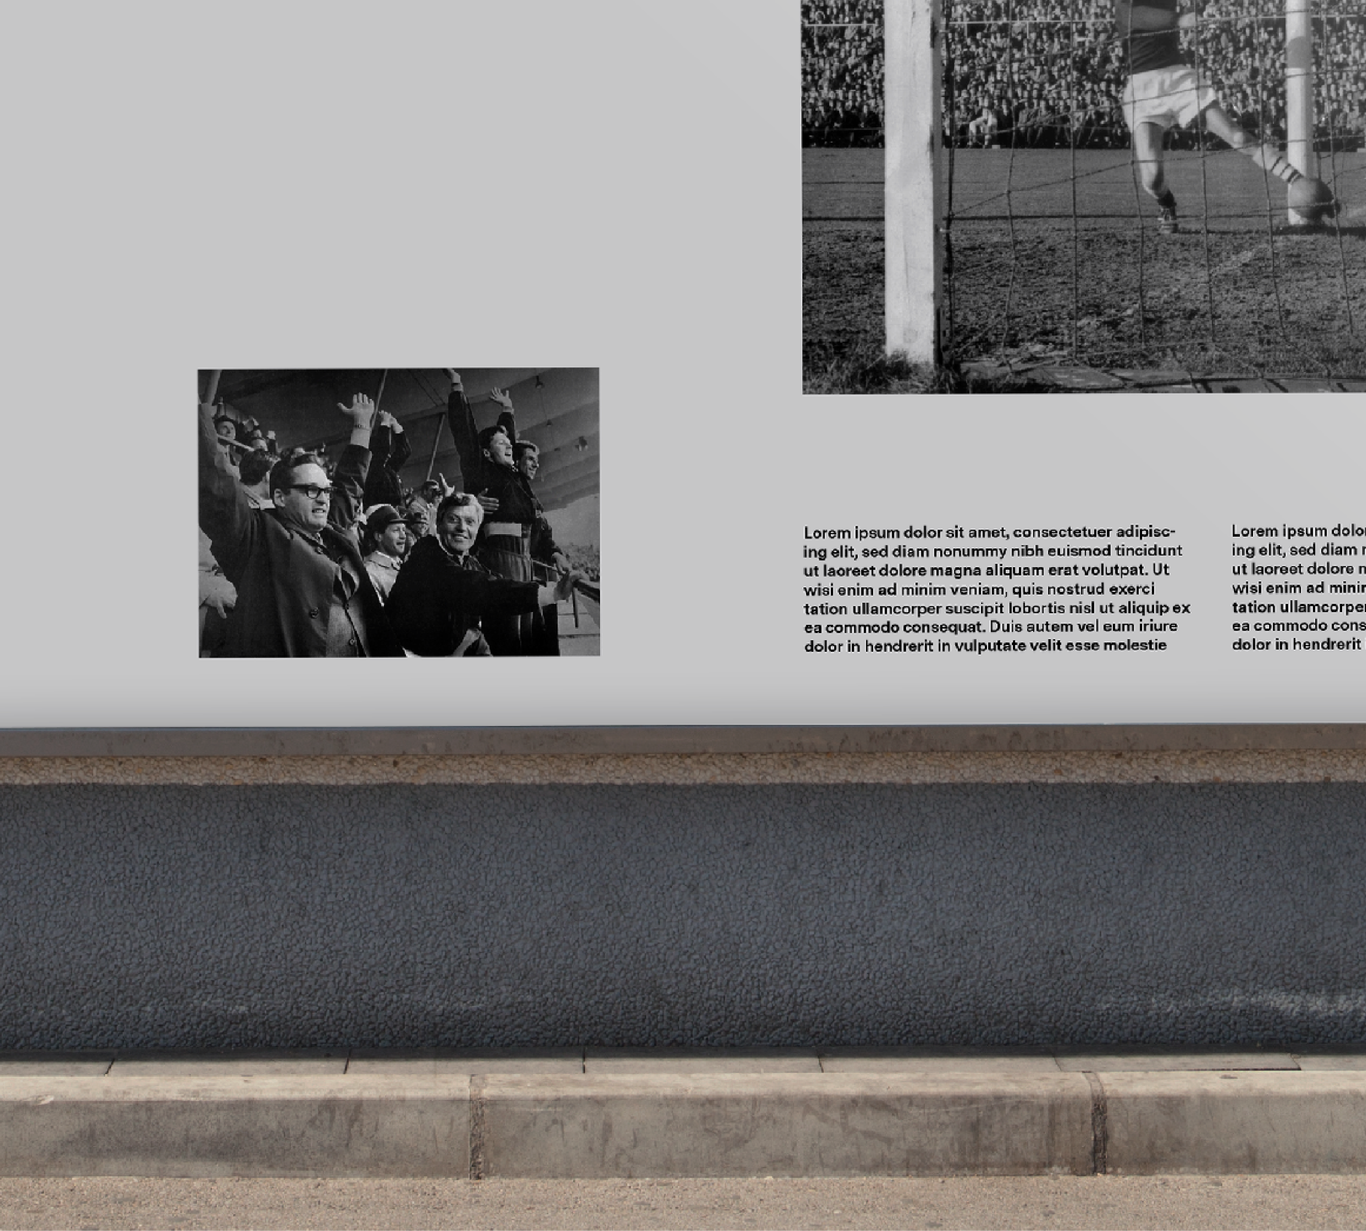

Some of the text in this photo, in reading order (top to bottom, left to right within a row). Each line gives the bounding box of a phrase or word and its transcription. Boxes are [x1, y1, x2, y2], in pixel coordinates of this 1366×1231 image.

[805, 525, 1175, 541] Lorem ipsum dolor sit amet, consectetuer adipisc-
[1233, 524, 1278, 537] Lorem
[1283, 524, 1327, 539] ipsum
[803, 544, 1182, 561] ing elit, sed diam nonummy nibh euismod tincidunt
[1233, 543, 1255, 558] ing
[1259, 542, 1286, 558] elit,
[1290, 542, 1316, 556] sed
[1321, 542, 1357, 556] diam
[803, 563, 1170, 579] ut laoreet dolore magna aliquam erat volutpat. Ut
[1233, 564, 1247, 575] ut
[1252, 562, 1304, 575] laoreet
[1307, 562, 1354, 574] dolore
[803, 582, 1154, 598] wisi enim ad minim veniam, quis nostrud exerci
[1232, 581, 1261, 595] wisi
[1266, 581, 1301, 594] enim
[1307, 581, 1324, 593] ad
[803, 601, 1191, 618] tation ullamcorper suscipit lobortis nisl ut aliquip ex
[1232, 600, 1275, 613] tation
[804, 619, 1178, 635] ea commodo consequat. Duis autem vel eum iriure
[1233, 623, 1249, 631] ea
[1254, 618, 1328, 631] commodo
[805, 639, 1167, 655] dolor in hendrerit in vulputate velit esse molestie
[1233, 638, 1271, 650] dolor
[1276, 638, 1288, 650] in
[1293, 637, 1361, 650] hendrerit
